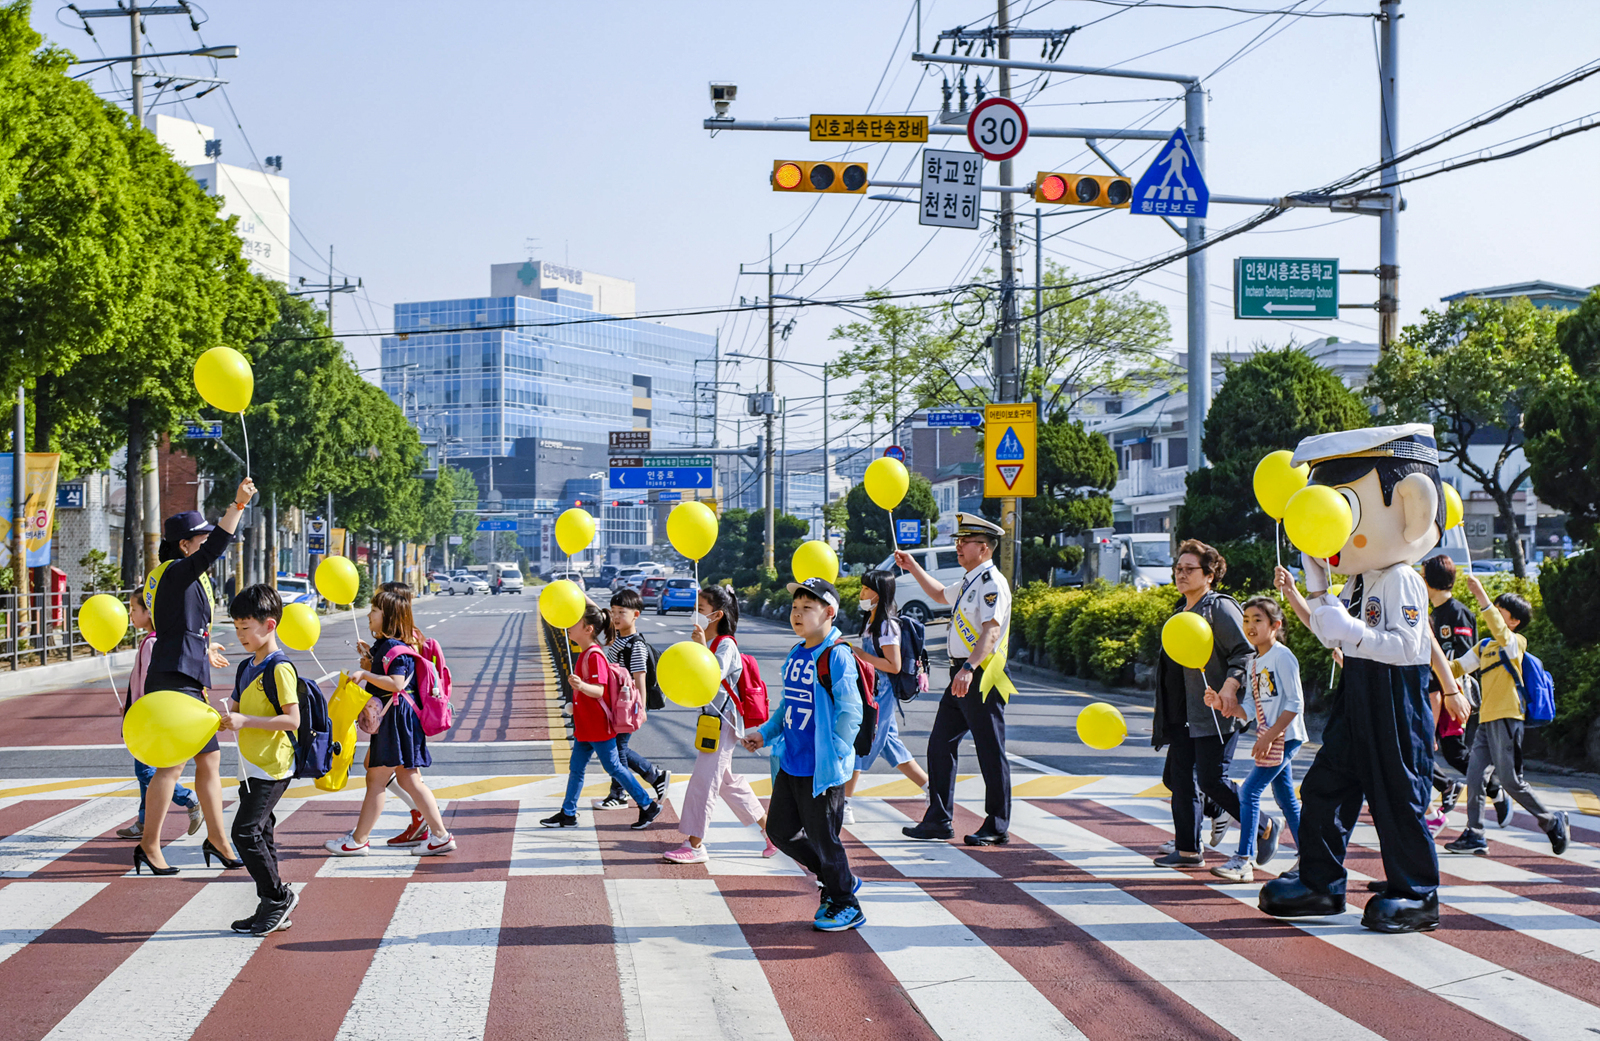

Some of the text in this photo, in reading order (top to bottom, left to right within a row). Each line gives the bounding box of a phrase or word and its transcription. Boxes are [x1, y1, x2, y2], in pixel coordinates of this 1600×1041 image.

[815, 118, 923, 138] 신호과속단속장비
[980, 117, 1017, 145] 30
[927, 157, 978, 186] 학교앞
[925, 191, 976, 222] 천천히
[1141, 200, 1196, 214] 횡단보도
[1246, 262, 1333, 281] 인천서흥초등학교
[1245, 285, 1333, 300] Incheon Seoheung Elementary School
[989, 410, 1032, 420] 어린이보호구역
[647, 470, 674, 480] 인중로
